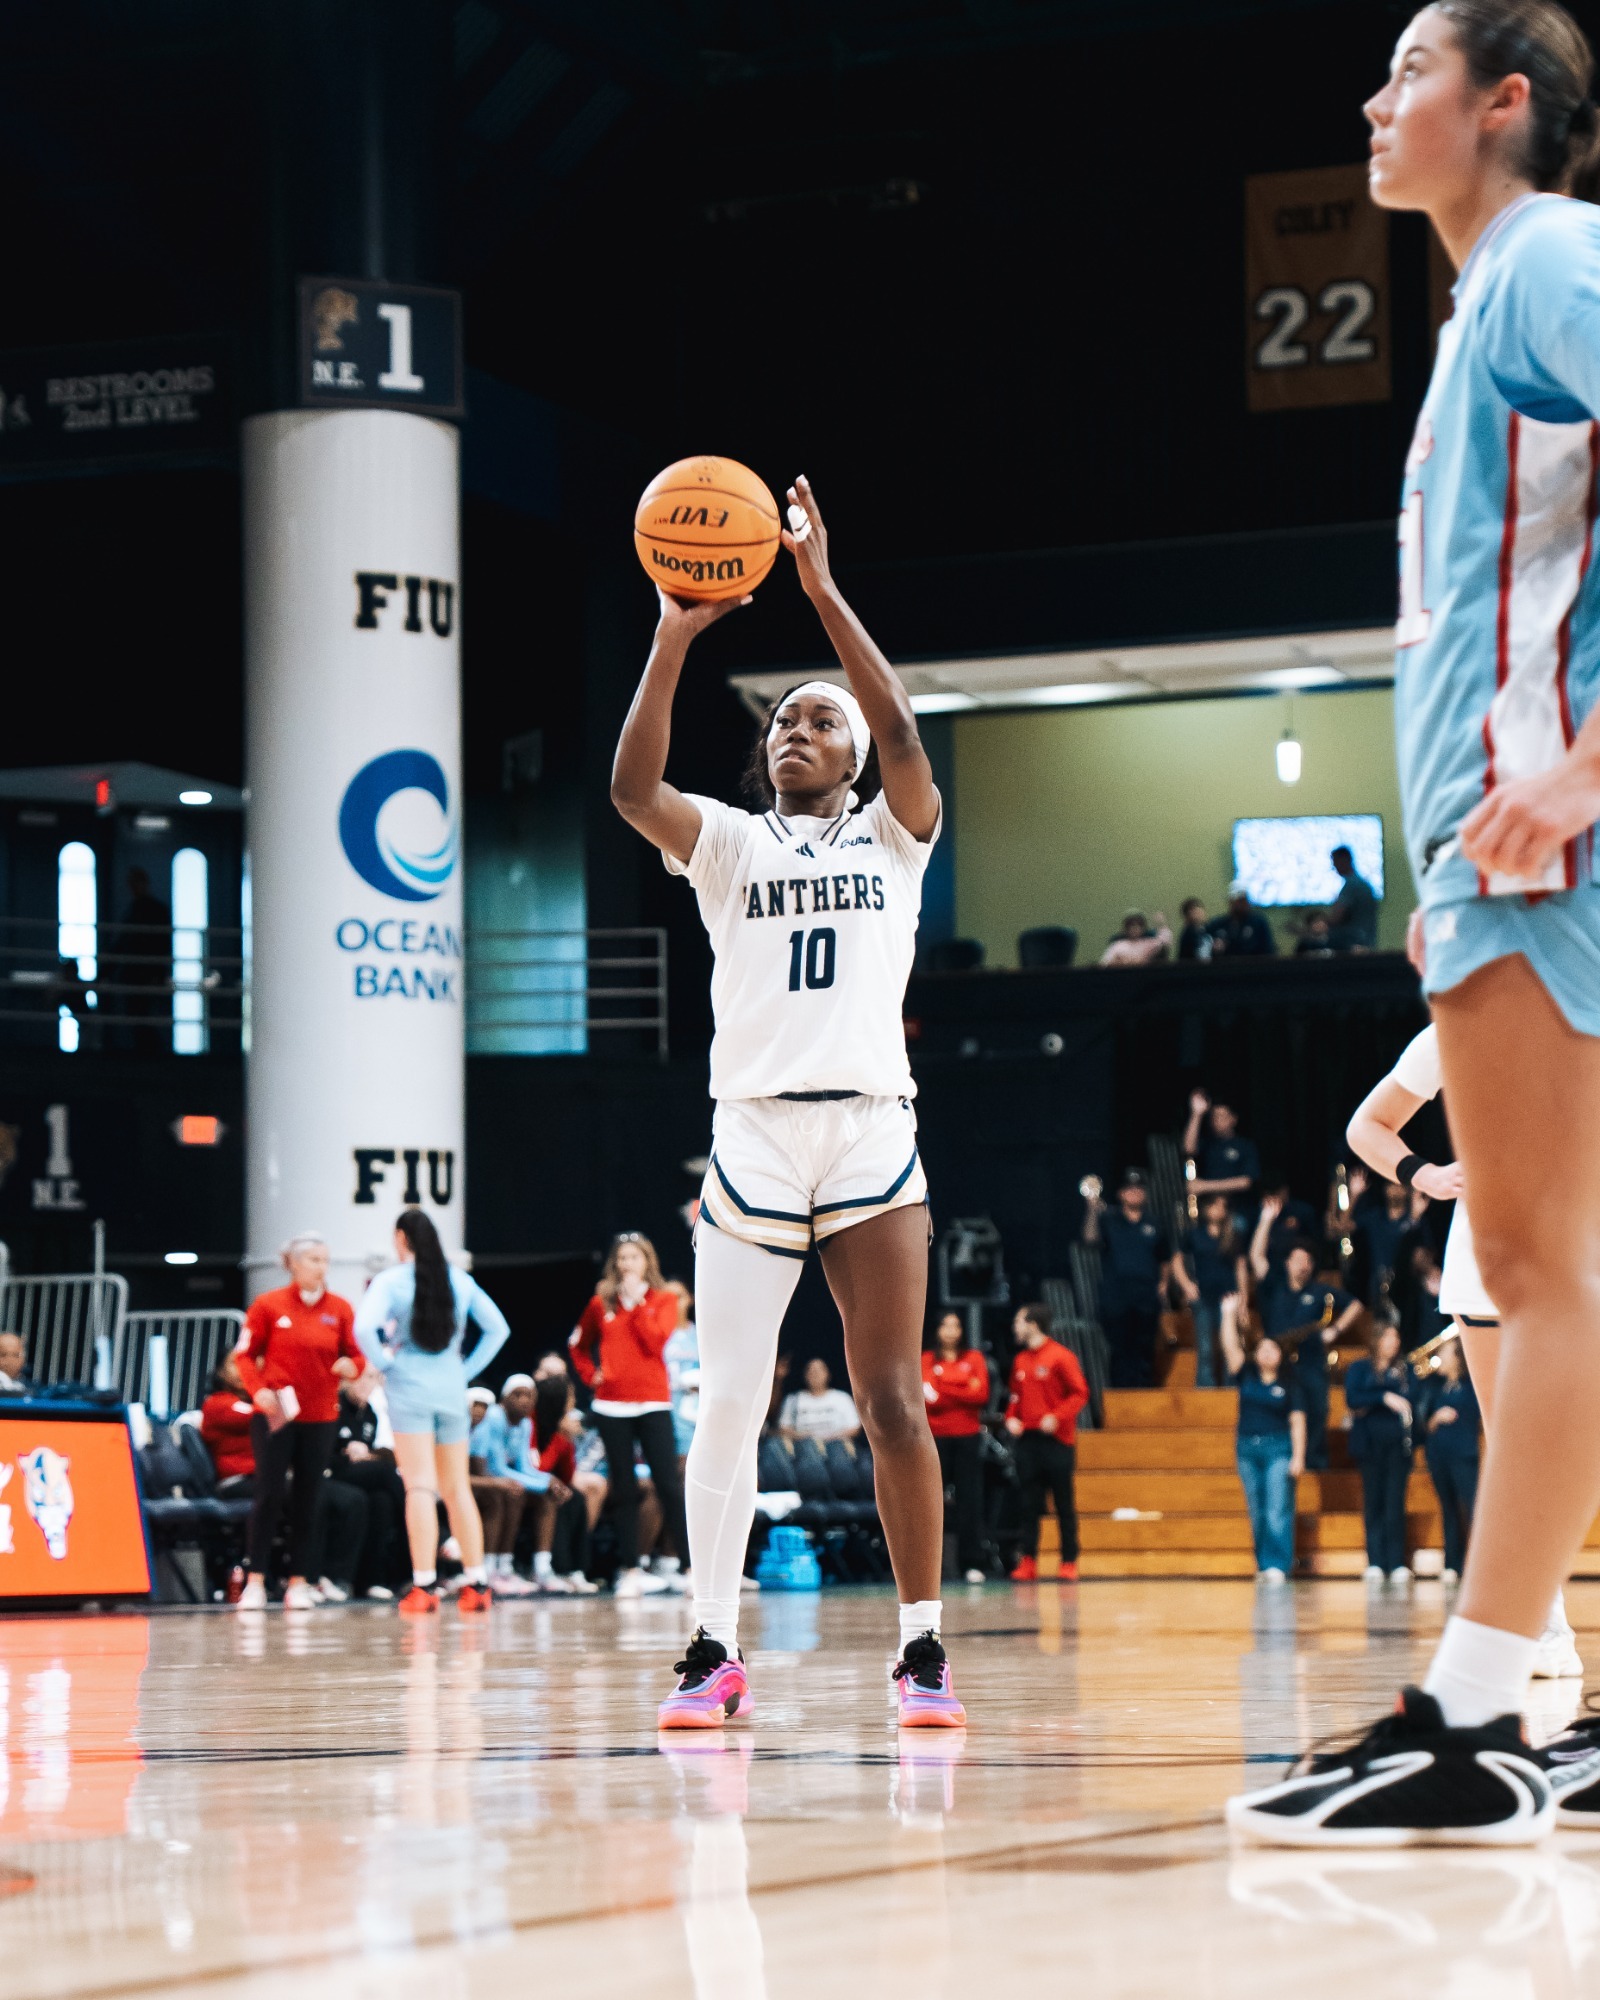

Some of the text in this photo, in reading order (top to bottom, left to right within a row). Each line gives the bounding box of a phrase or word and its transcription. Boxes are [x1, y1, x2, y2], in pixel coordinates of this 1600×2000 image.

[313, 303, 424, 391] N.E. 1
[1255, 277, 1376, 369] 22
[46, 365, 215, 405] RESTROOMS
[62, 395, 200, 432] 2nd LEVEL
[652, 548, 745, 582] Wilson
[354, 570, 455, 637] FIU
[743, 873, 885, 919] ANTHERS
[336, 918, 461, 958] OCEAN
[789, 927, 836, 992] 10
[354, 964, 456, 1003] BANK
[45, 1104, 73, 1177] 1
[353, 1148, 454, 1206] FIU
